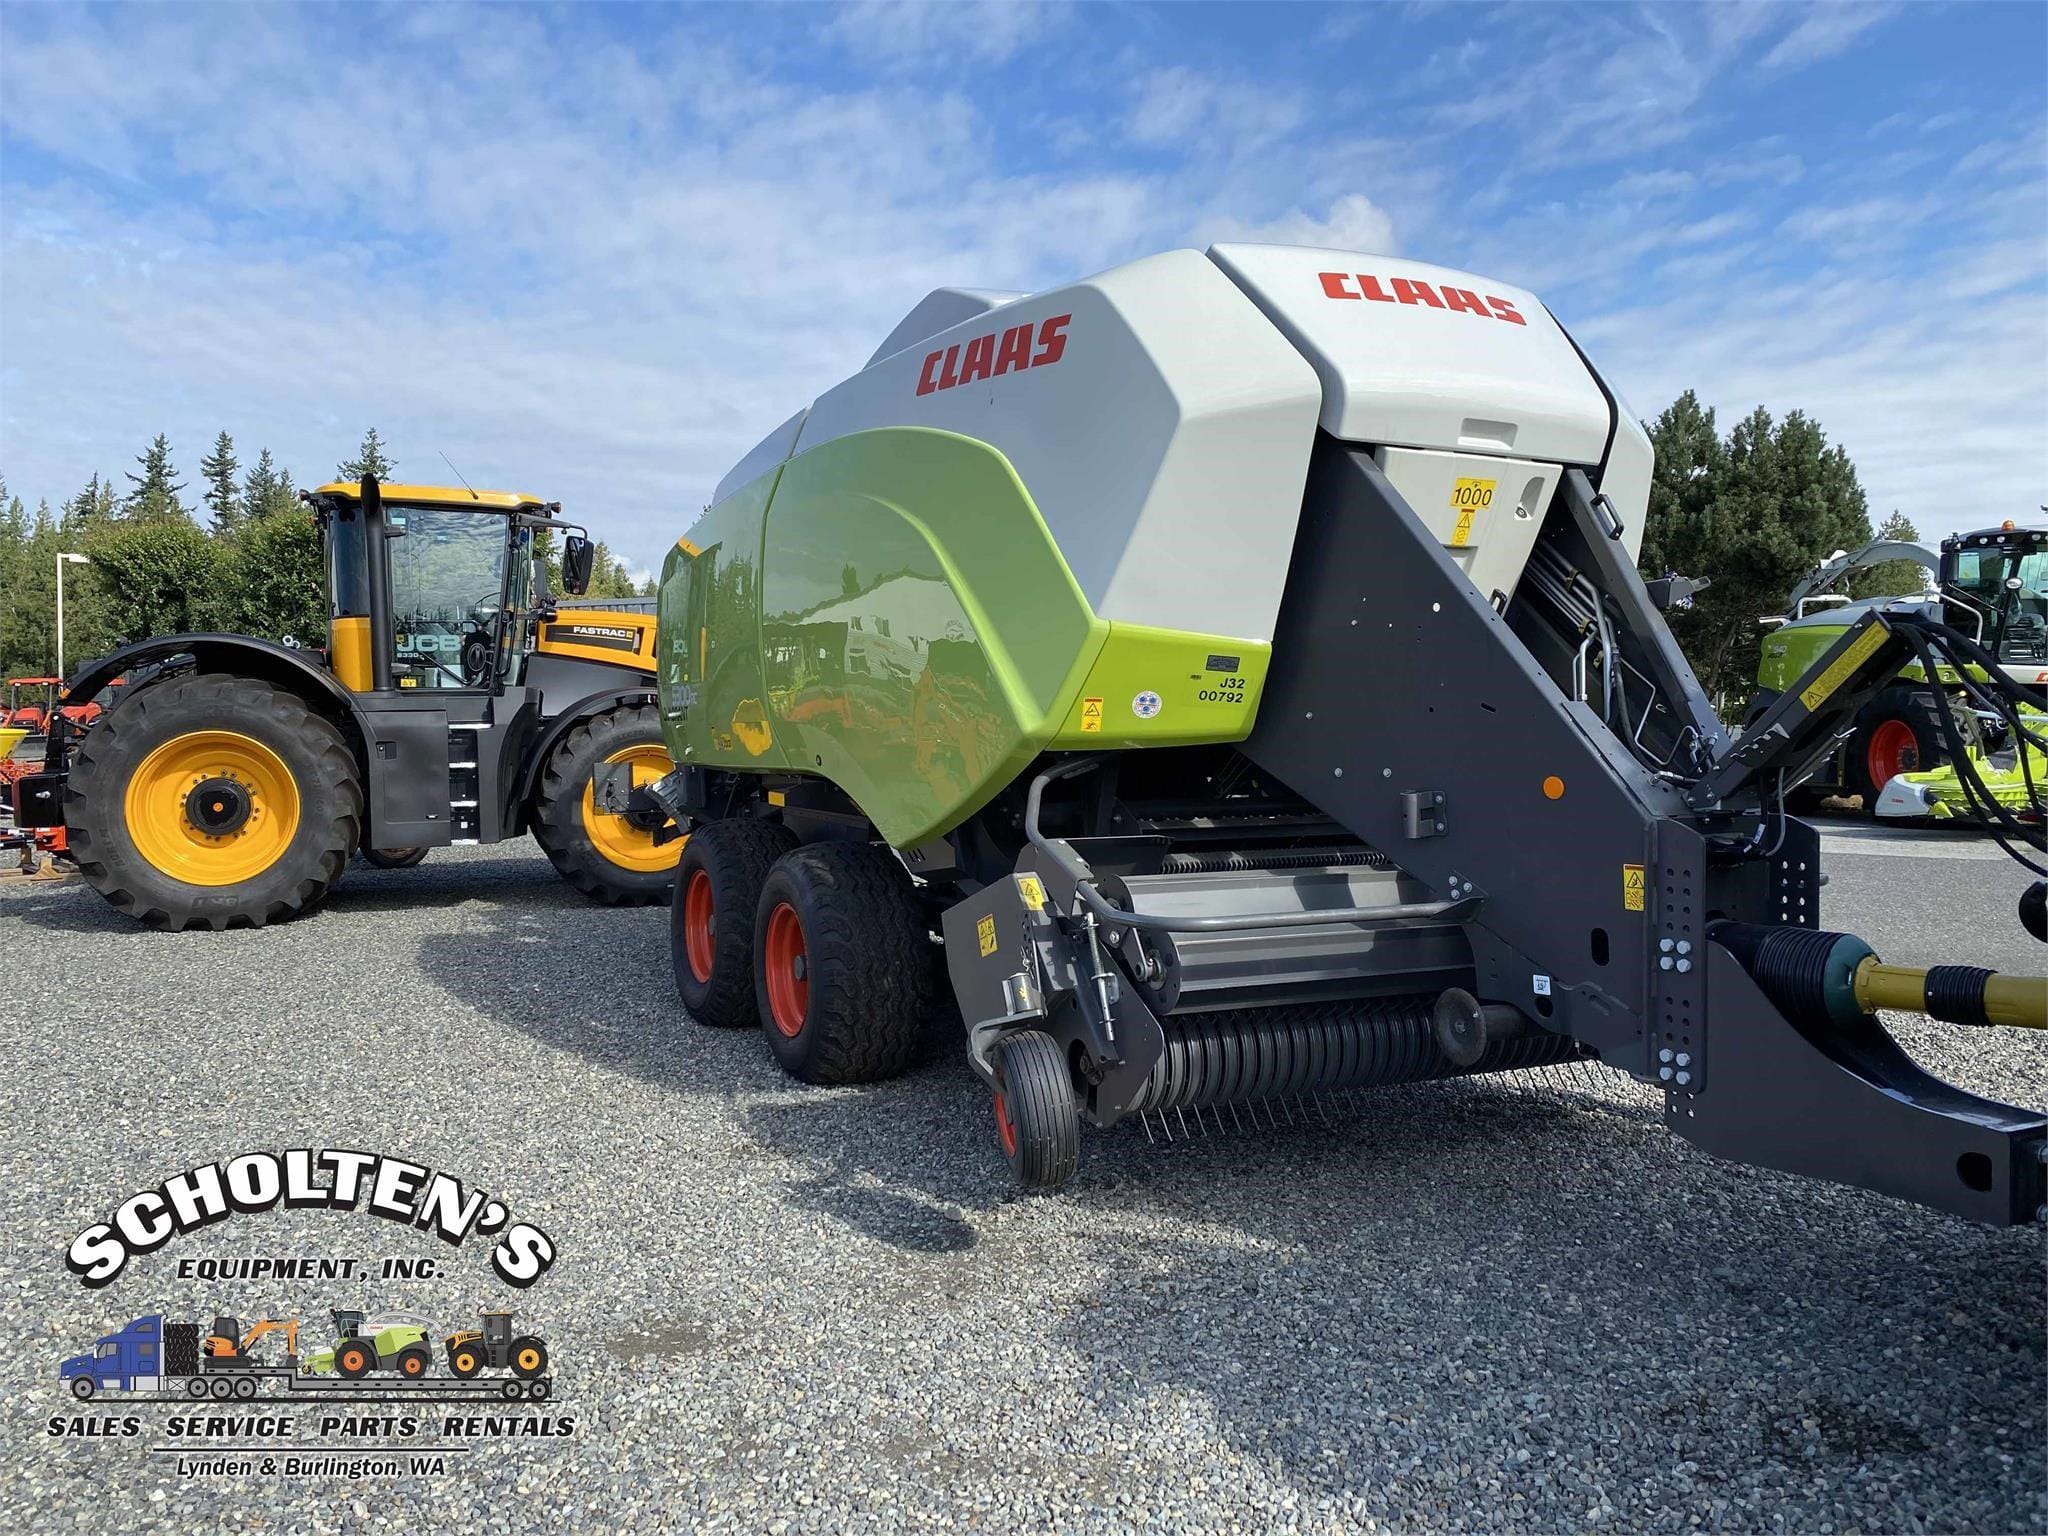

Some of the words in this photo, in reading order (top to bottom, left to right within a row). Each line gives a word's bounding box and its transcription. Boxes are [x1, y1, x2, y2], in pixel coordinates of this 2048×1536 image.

[1318, 272, 1527, 326] CLAAS
[916, 313, 1072, 396] CLAAS
[1455, 487, 1493, 506] 1000
[573, 626, 626, 638] FASTRAC
[396, 634, 462, 652] JCB
[1219, 678, 1246, 689] J32
[1198, 690, 1244, 703] 00792
